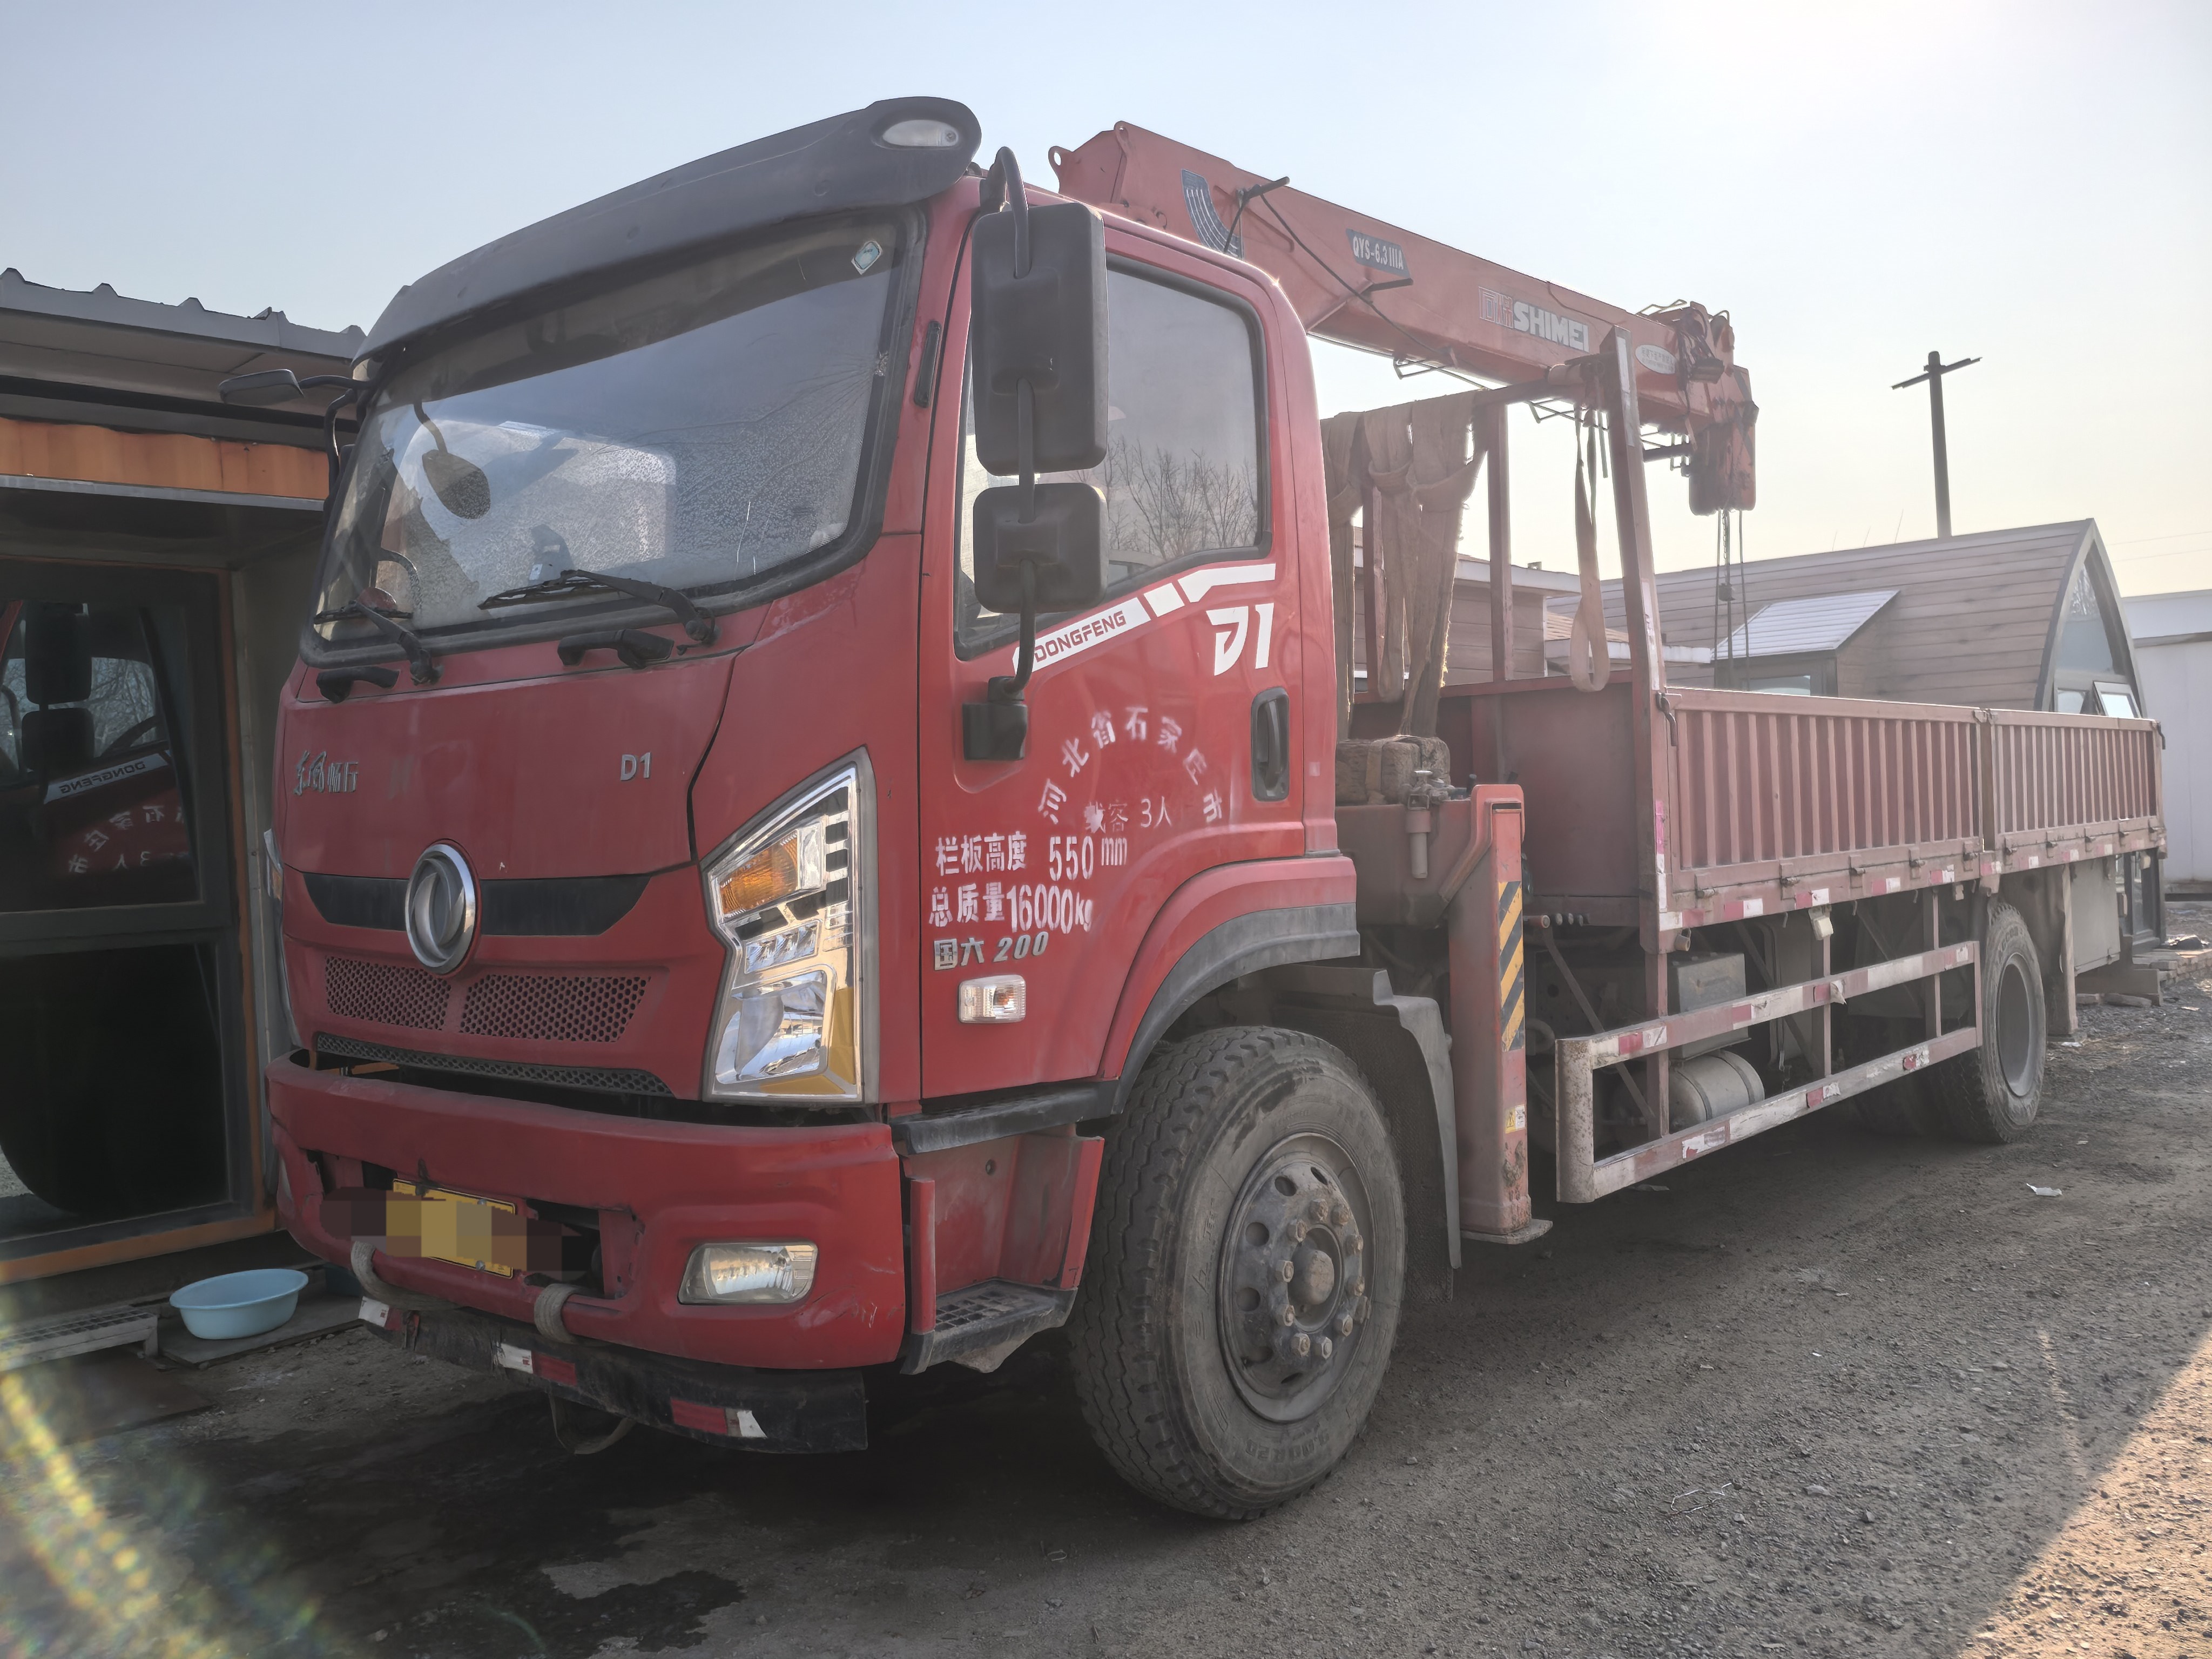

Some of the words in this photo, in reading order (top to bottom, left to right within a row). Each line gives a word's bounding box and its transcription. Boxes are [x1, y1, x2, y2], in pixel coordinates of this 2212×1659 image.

[1514, 301, 1589, 353] SHIMEI
[1034, 611, 1127, 663] DONGFENG
[620, 752, 652, 781] D1
[1141, 796, 1172, 828] 3人
[935, 831, 1027, 876] 栏板高度
[1049, 835, 1094, 881] 550
[934, 938, 984, 970] 国六
[993, 932, 1049, 962] 200
